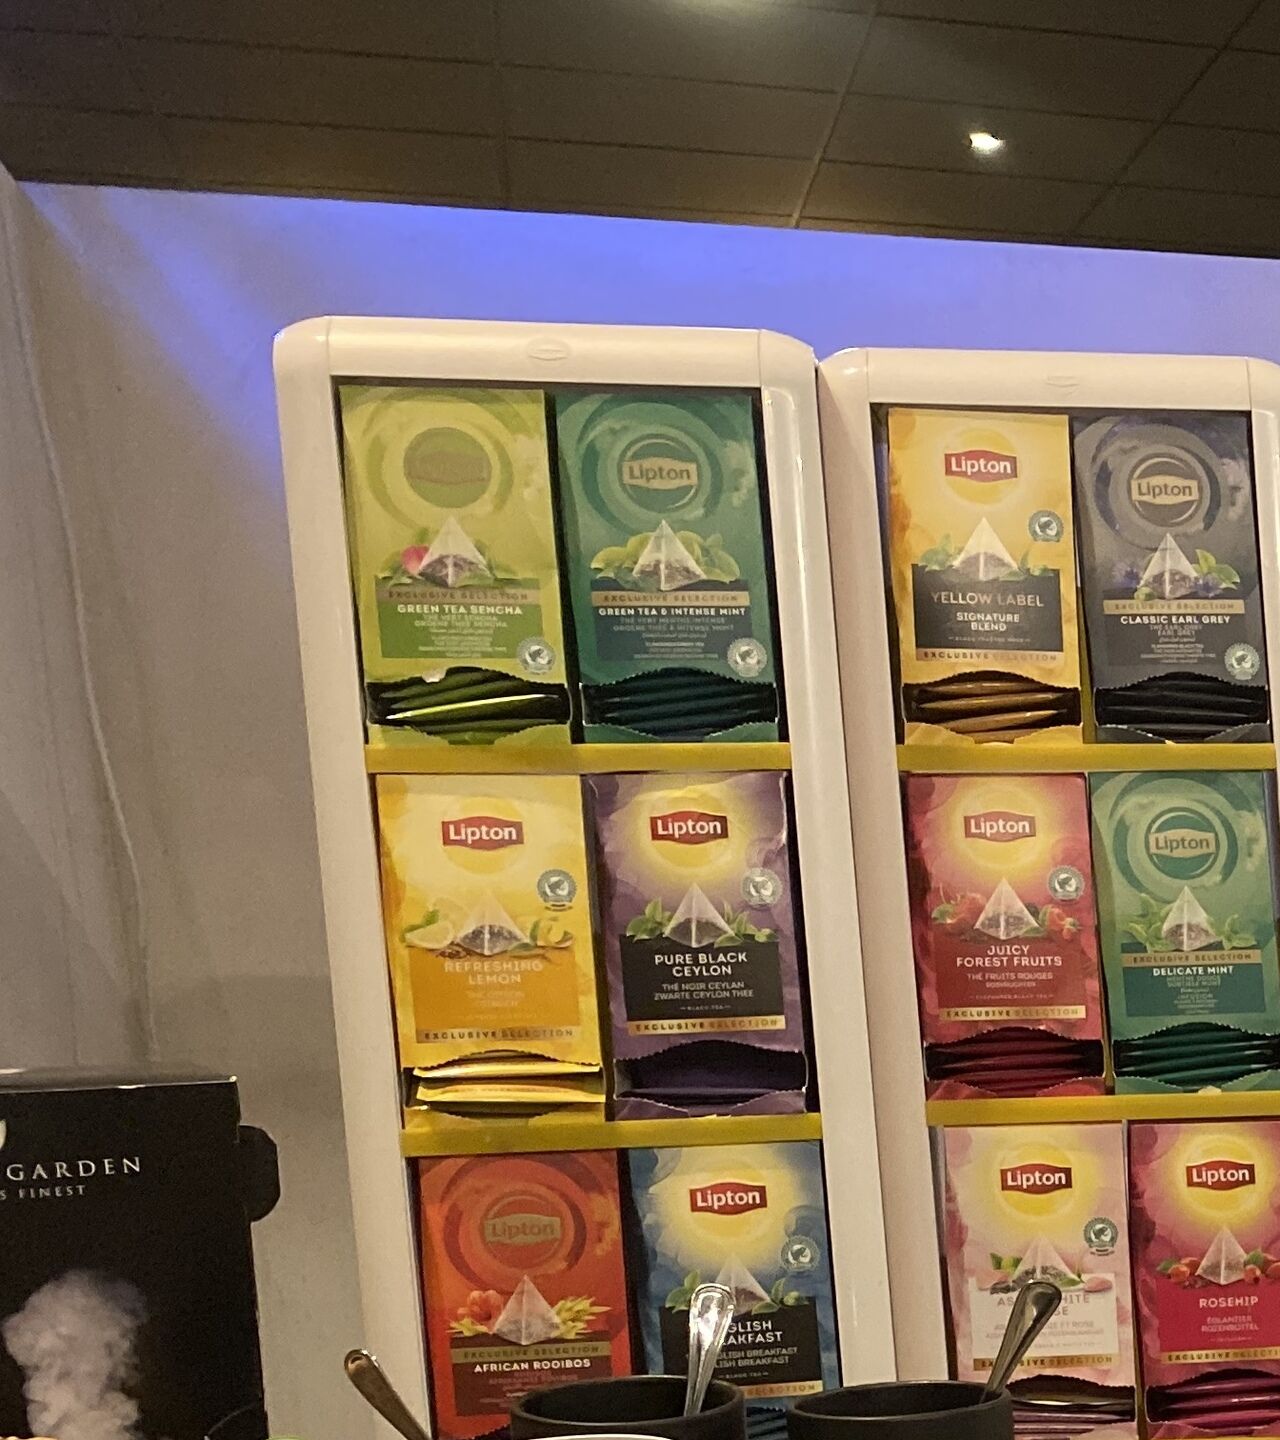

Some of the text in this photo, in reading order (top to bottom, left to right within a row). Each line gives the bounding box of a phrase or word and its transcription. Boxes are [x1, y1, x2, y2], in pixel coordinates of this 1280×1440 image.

[951, 456, 1011, 476] Lipton
[629, 464, 691, 482] Lipton
[1137, 480, 1193, 499] Lipton
[931, 592, 1044, 607] YELLOW LABEL
[397, 604, 523, 615] GREEN TEA SENCHA
[598, 607, 635, 616] GREEN
[638, 607, 658, 616] TEA
[671, 607, 716, 616] INTENSE
[719, 607, 746, 616] MINT
[956, 611, 1020, 622] SIGNATURE
[1120, 615, 1231, 624] CLASSIC EARL GREY
[971, 622, 1006, 631] BLEND
[656, 814, 722, 837] Lipton
[969, 816, 1030, 836] Lipton
[449, 820, 517, 844] Lipton
[1155, 834, 1210, 854] Lipton
[987, 945, 1030, 956] JUICY
[654, 952, 748, 965] PURE BLACK
[956, 956, 1063, 967] FOREST FRUITS
[444, 960, 543, 972] REFRESHING
[672, 965, 732, 977] CEYLON
[1153, 965, 1234, 976] DELICATE MINT
[469, 974, 521, 985] LEMON
[681, 982, 706, 991] NOIR
[708, 981, 745, 990] CEYLAN
[654, 989, 754, 1000] ZWARTE CEYLON THEE
[946, 1010, 1011, 1018] EXCLUSIVE
[636, 1022, 704, 1031] EXCLUSIVE
[425, 1029, 573, 1040] EXCLUSIVE SELECTION
[6, 1156, 140, 1181] GARDEN
[1006, 1170, 1066, 1188] Lipton
[1192, 1166, 1250, 1184] Lipton
[18, 1185, 86, 1199] FINEST
[695, 1188, 761, 1209] Lipton
[491, 1220, 556, 1241] Lipton
[1062, 1293, 1090, 1305] HITE
[1199, 1296, 1259, 1308] ROSEHIP
[728, 1320, 773, 1333] GLISH
[722, 1332, 783, 1346] AKFAST
[747, 1347, 798, 1356] BREAKFAST
[1168, 1352, 1229, 1361] EXCLUSIVE
[474, 1359, 591, 1373] AFRICAN ROOIBOS
[738, 1356, 789, 1366] BREAKFAST
